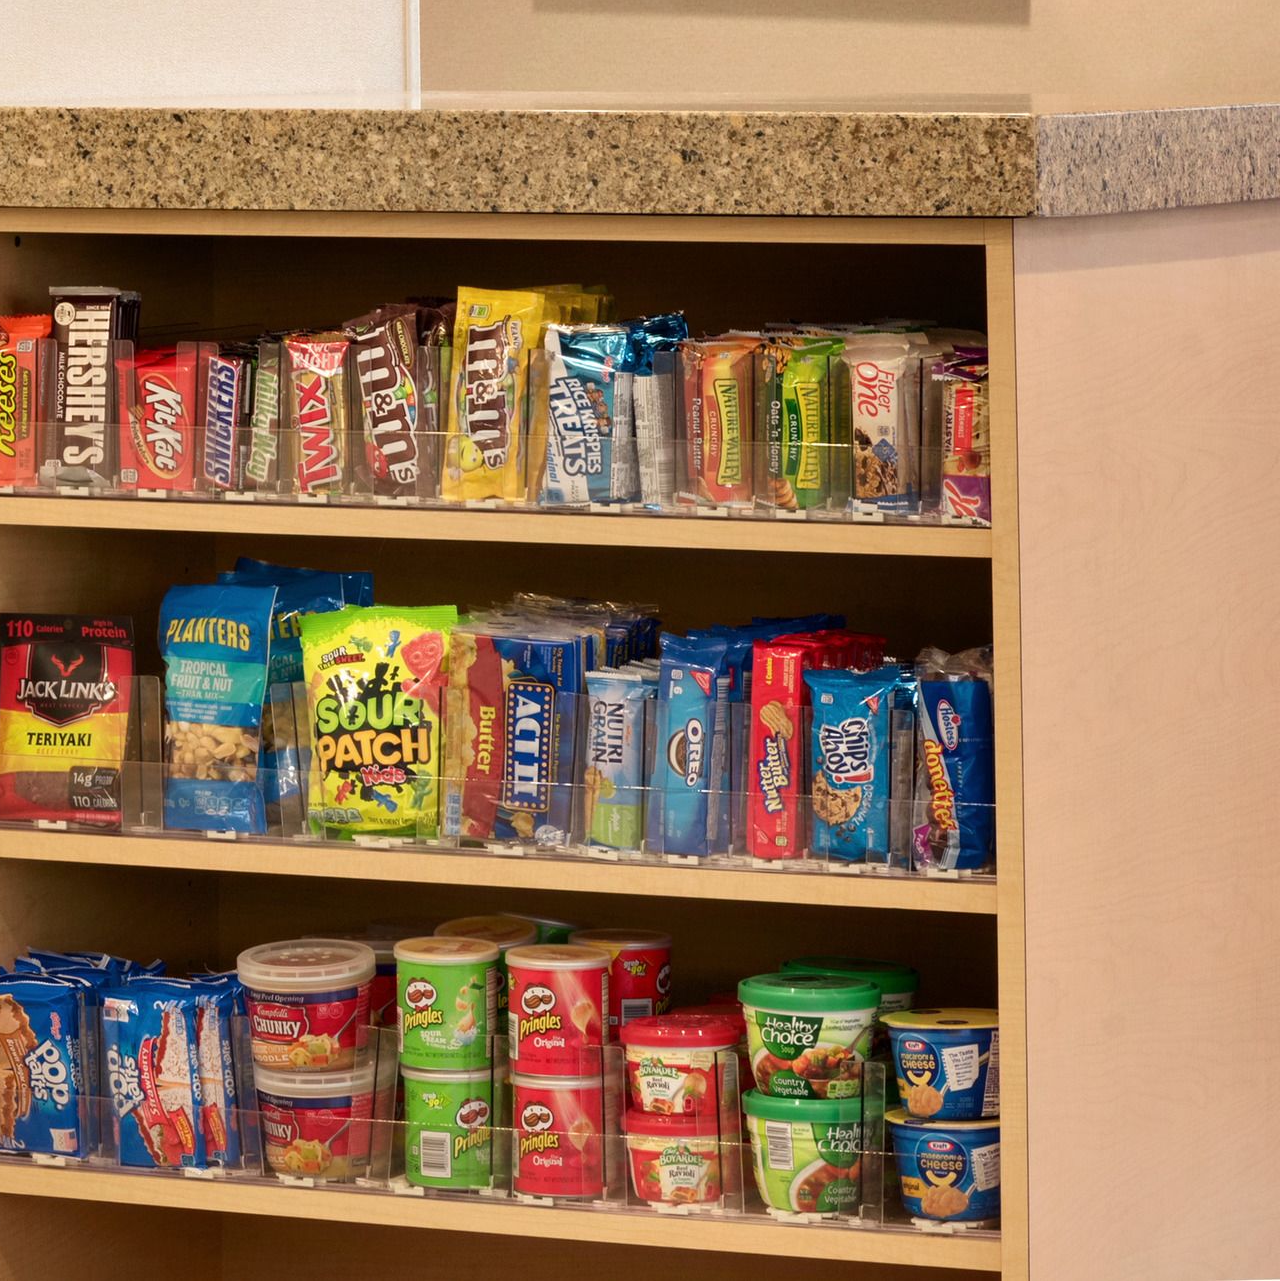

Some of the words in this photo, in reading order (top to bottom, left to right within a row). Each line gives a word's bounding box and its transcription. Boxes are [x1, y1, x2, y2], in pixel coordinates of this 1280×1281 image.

[395, 320, 404, 337] MILK
[508, 320, 522, 350] PEANUT
[58, 351, 66, 370] MILK
[398, 338, 411, 366] CHOCOLATE
[56, 371, 64, 419] CHOCOLATE
[62, 310, 112, 466] HERSHEY'S
[855, 361, 880, 417] One
[876, 369, 895, 414] Fiber
[692, 398, 702, 434] Peanut
[719, 383, 737, 435] NATURE
[770, 400, 781, 425] Oats
[800, 386, 819, 442] NATURE
[216, 364, 236, 483] SNICKERS
[549, 378, 587, 477] TREATS
[565, 378, 592, 408] RICE
[580, 409, 602, 475] KRISPIES
[710, 411, 718, 457] CRUNCHY
[790, 414, 798, 461] CRUNCHY
[944, 411, 955, 453] PASTRY
[693, 437, 703, 470] Butter
[721, 436, 739, 483] VALLEY
[769, 441, 781, 474] Honey
[801, 443, 819, 488] VALLEY
[6, 620, 33, 637] 110
[35, 625, 64, 633] Calories
[81, 626, 128, 638] Protein
[166, 617, 251, 652] PLANTERS
[180, 660, 229, 677] TROPICAL
[322, 646, 347, 663] SOUR
[16, 679, 57, 700] JACK
[59, 680, 116, 700] LINK'S
[170, 674, 202, 688] FRUIT
[203, 676, 211, 688] &
[213, 678, 234, 691] NUT
[316, 692, 424, 734] SOUR
[27, 732, 92, 747] TERIYAKI
[477, 705, 496, 775] Butter
[592, 701, 608, 765] GRAIN
[607, 702, 625, 765] NUTRI
[939, 706, 955, 750] Hostess
[317, 728, 429, 776] PATCH
[685, 717, 704, 787] OREO
[840, 718, 870, 772] Chips
[360, 764, 407, 787] Kids
[766, 738, 788, 788] Butter
[73, 772, 92, 787] 14g
[759, 761, 783, 813] Nutter
[923, 738, 958, 831] donettes
[73, 795, 91, 807] 110
[851, 784, 874, 826] ORIGINAL
[253, 1015, 301, 1039] CHUNKY
[404, 1007, 443, 1035] Pringles
[520, 1012, 562, 1041] Pringles
[764, 1016, 819, 1033] Healthy
[533, 1036, 566, 1048] Original
[761, 1026, 815, 1047] Choice
[780, 1044, 795, 1054] Soup
[907, 1041, 921, 1049] Kraft
[901, 1053, 928, 1061] macaroni
[958, 1049, 974, 1057] Taste
[140, 1047, 160, 1117] Strawberry
[639, 1064, 679, 1079] BOYARDEE
[646, 1080, 670, 1090] Ravioli
[773, 1076, 806, 1088] Country
[773, 1085, 809, 1097] Vegetable
[520, 1131, 559, 1159] Pringles
[920, 1152, 955, 1160] macaroni
[932, 1142, 948, 1150] Kraft
[532, 1155, 563, 1167] Original
[660, 1153, 703, 1166] BOYARDEE
[668, 1169, 696, 1178] Ravioli
[827, 1184, 857, 1195] Country
